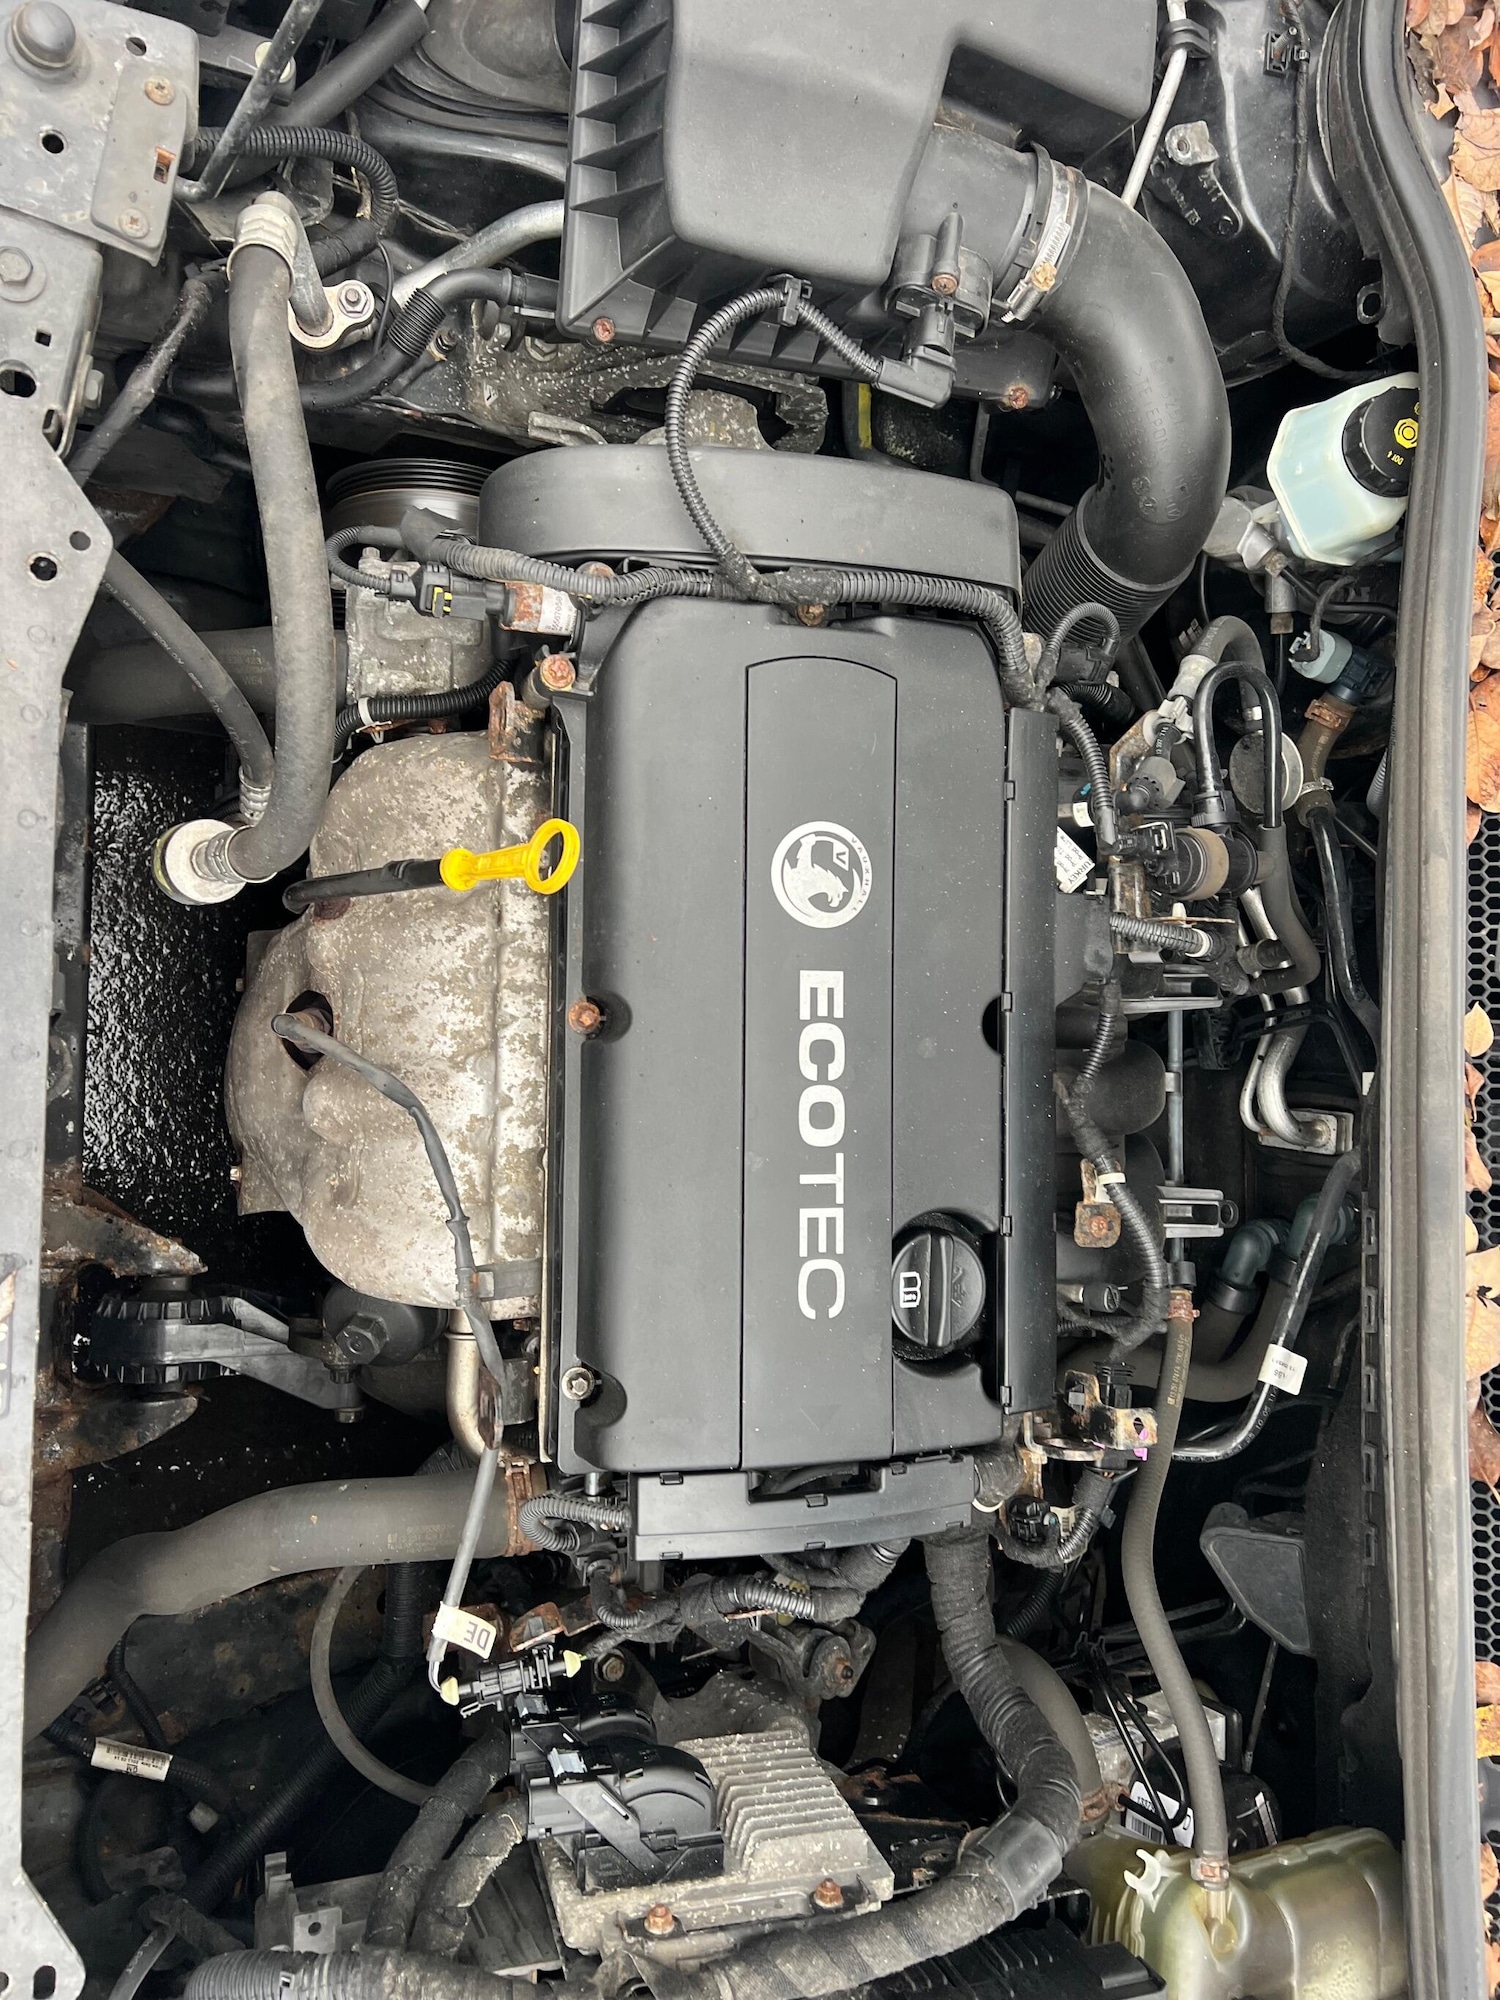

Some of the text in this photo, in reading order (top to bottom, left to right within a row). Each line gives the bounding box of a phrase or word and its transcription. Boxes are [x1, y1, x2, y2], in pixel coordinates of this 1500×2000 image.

[1391, 453, 1405, 466] DOT
[152, 630, 171, 650] HOSE
[836, 851, 847, 865] V
[851, 837, 871, 912] VAUXHALL
[798, 970, 846, 1320] ECOTEC
[463, 1620, 491, 1651] DE
